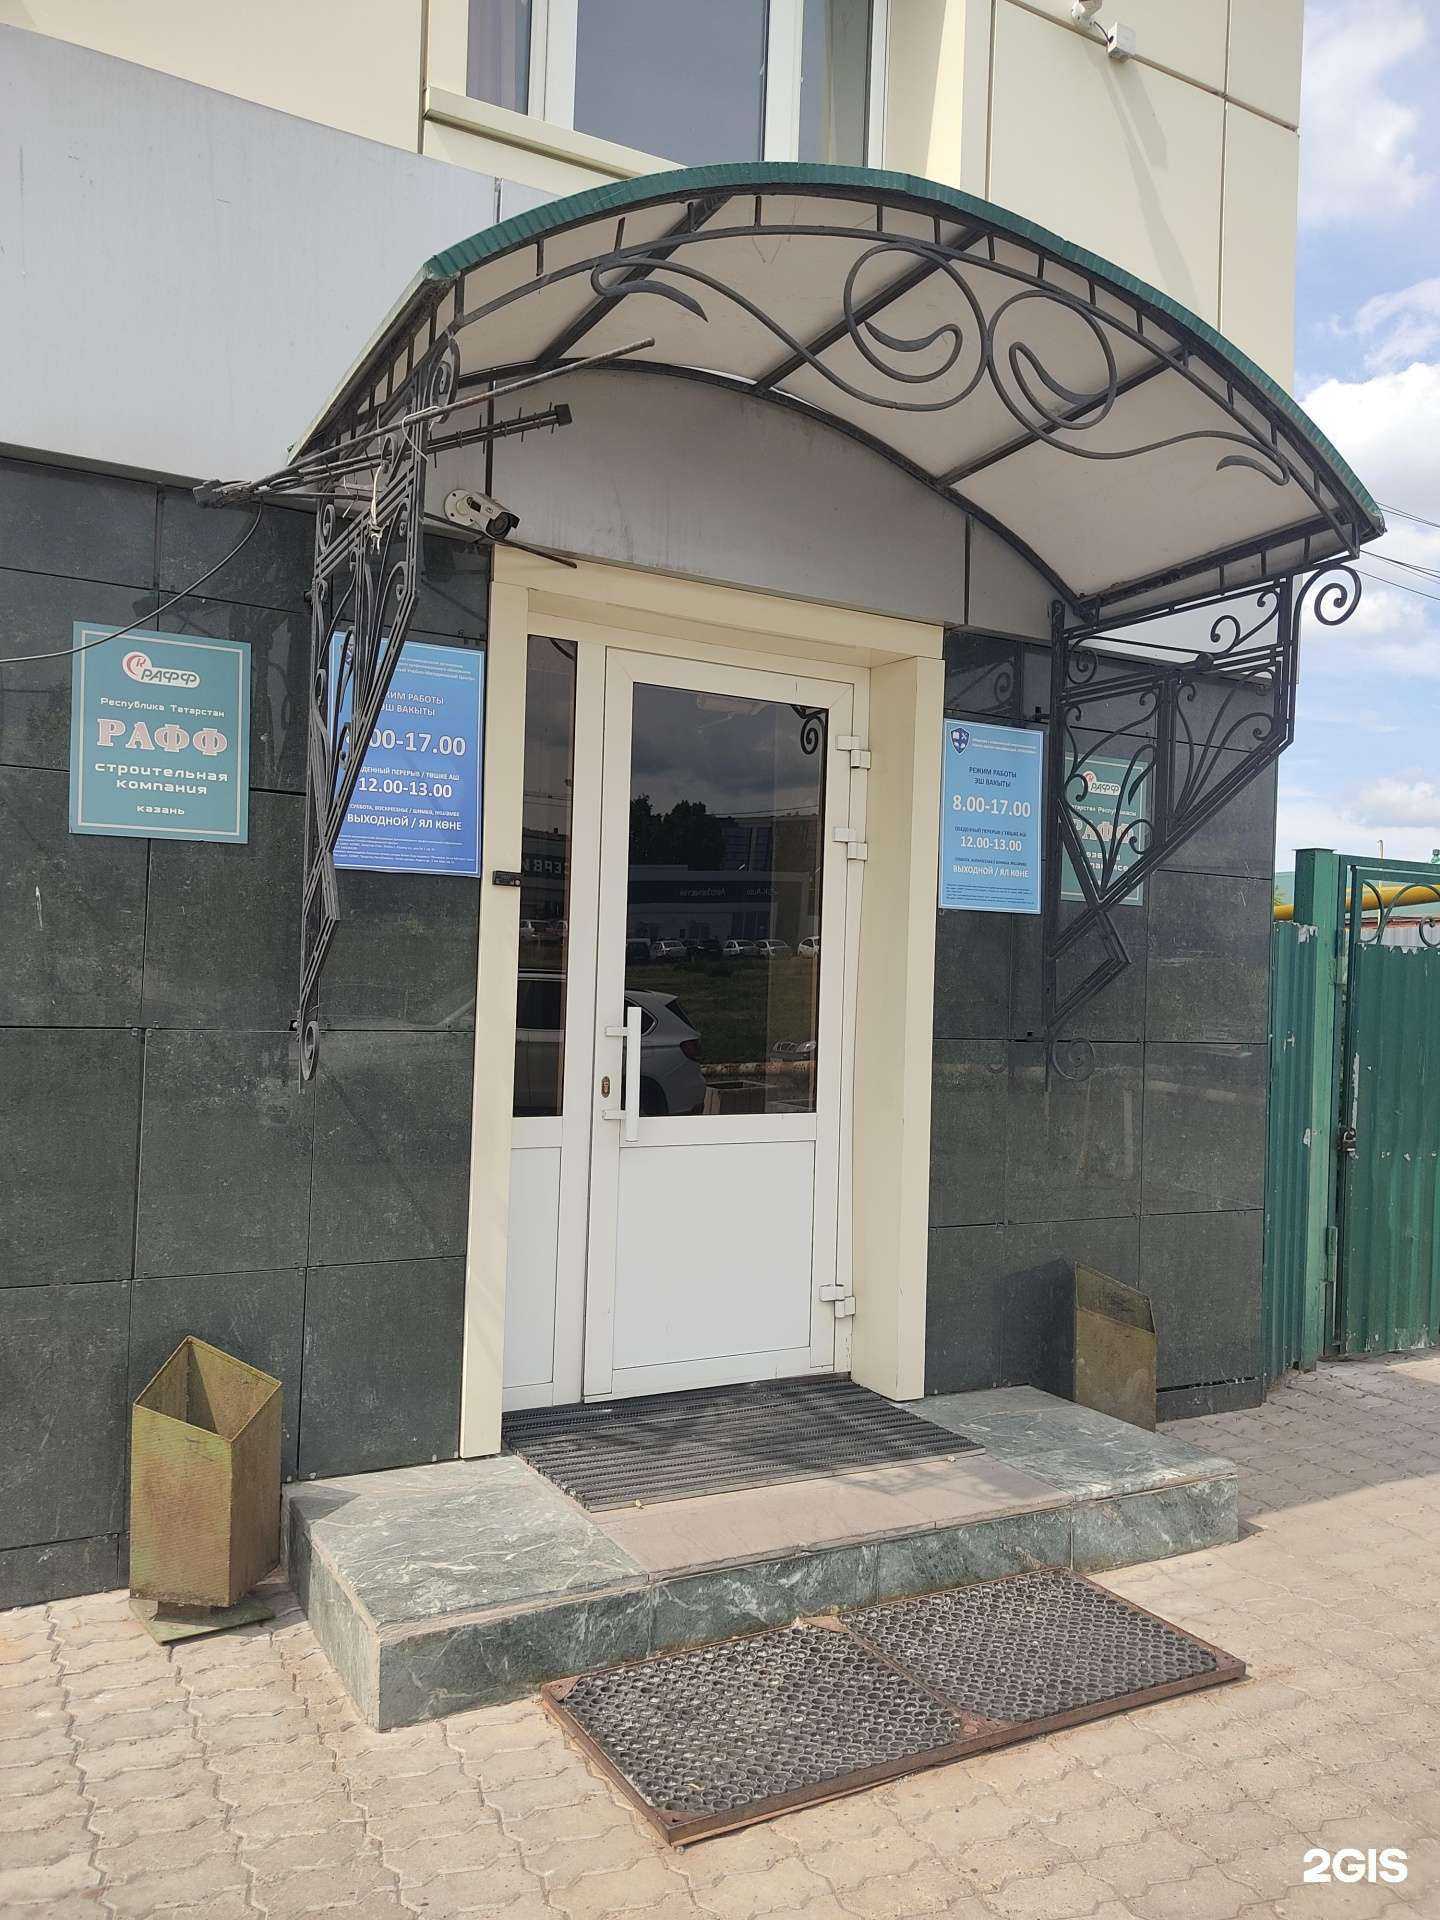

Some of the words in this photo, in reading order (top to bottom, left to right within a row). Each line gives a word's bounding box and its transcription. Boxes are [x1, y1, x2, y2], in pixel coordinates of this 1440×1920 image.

[408, 693, 444, 705] РАБОТЫ
[100, 697, 165, 712] Республика
[170, 704, 225, 718] Татарстан
[397, 705, 435, 717] ВАКЫТЫ
[96, 718, 228, 756] РАФФ
[368, 728, 466, 756] 00-17.00
[94, 762, 229, 782] строительная
[360, 766, 391, 776] ДЕННЫЙ
[968, 766, 992, 776] РЕЖИМ
[992, 768, 1017, 778] РАБОТЫ
[116, 779, 208, 795] компания
[358, 777, 453, 798] 12.00-13.00
[974, 777, 985, 785] ЭШ
[952, 794, 1031, 818] 8.00-17.00
[347, 813, 409, 827] ВЫХОДНОЙ
[411, 818, 416, 829] /
[419, 818, 433, 829] ЯЛ
[960, 836, 1022, 852] 12.00-13.00
[952, 864, 994, 876] ВЫХОДНОЙ
[999, 867, 1009, 877] ЯЛ
